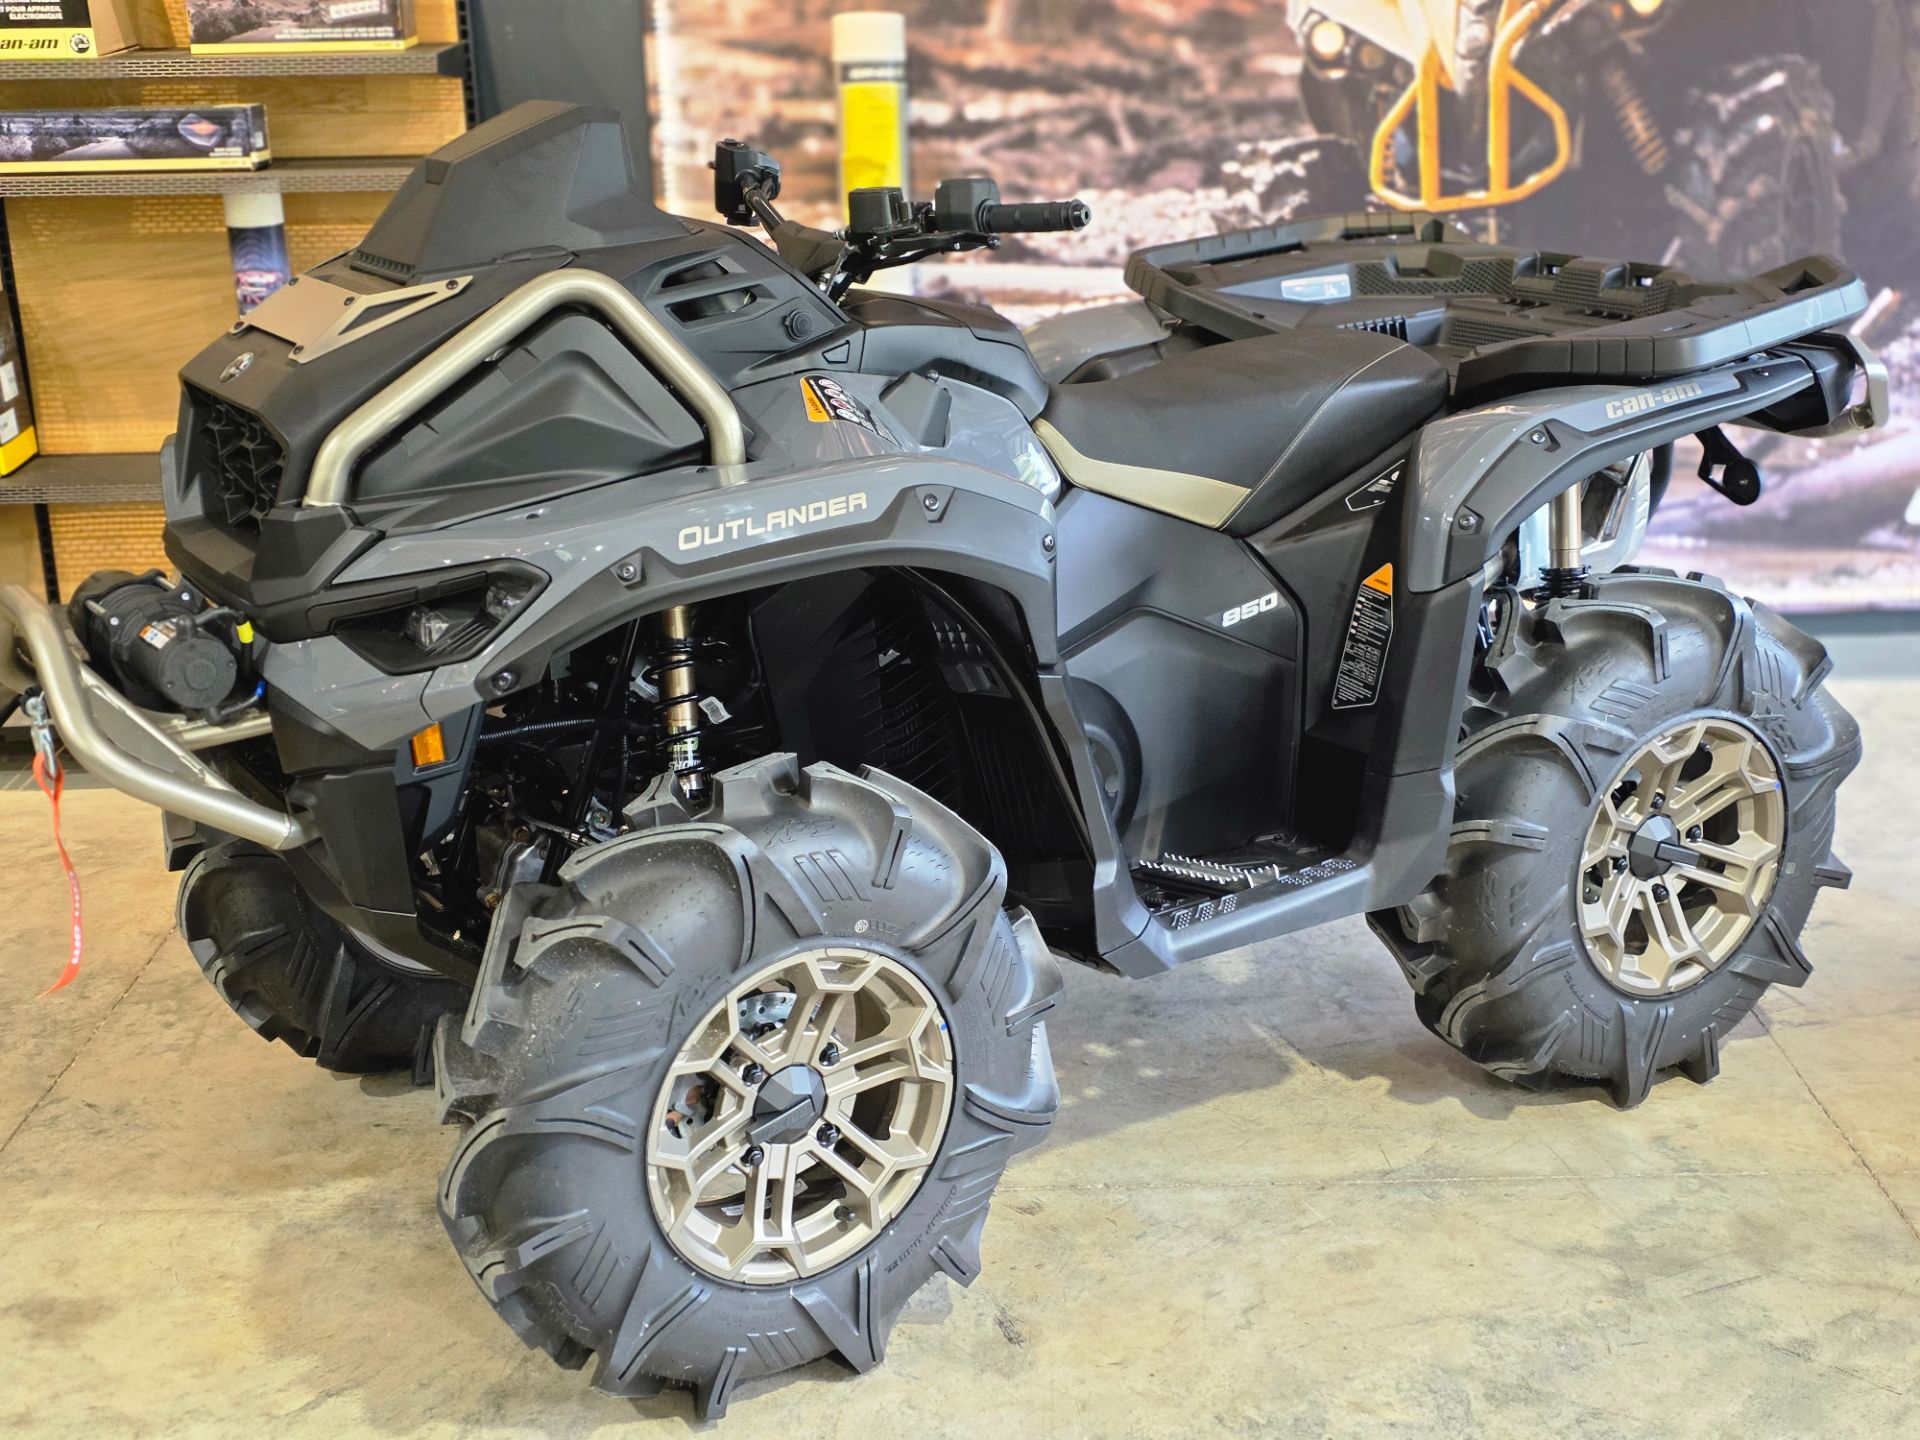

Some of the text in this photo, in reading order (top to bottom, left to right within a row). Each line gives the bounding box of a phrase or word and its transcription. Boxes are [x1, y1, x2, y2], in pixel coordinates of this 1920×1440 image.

[0, 38, 59, 50] an-am
[1606, 382, 1703, 419] can-am
[678, 491, 868, 551] OUTLANDER
[1222, 591, 1278, 628] 850
